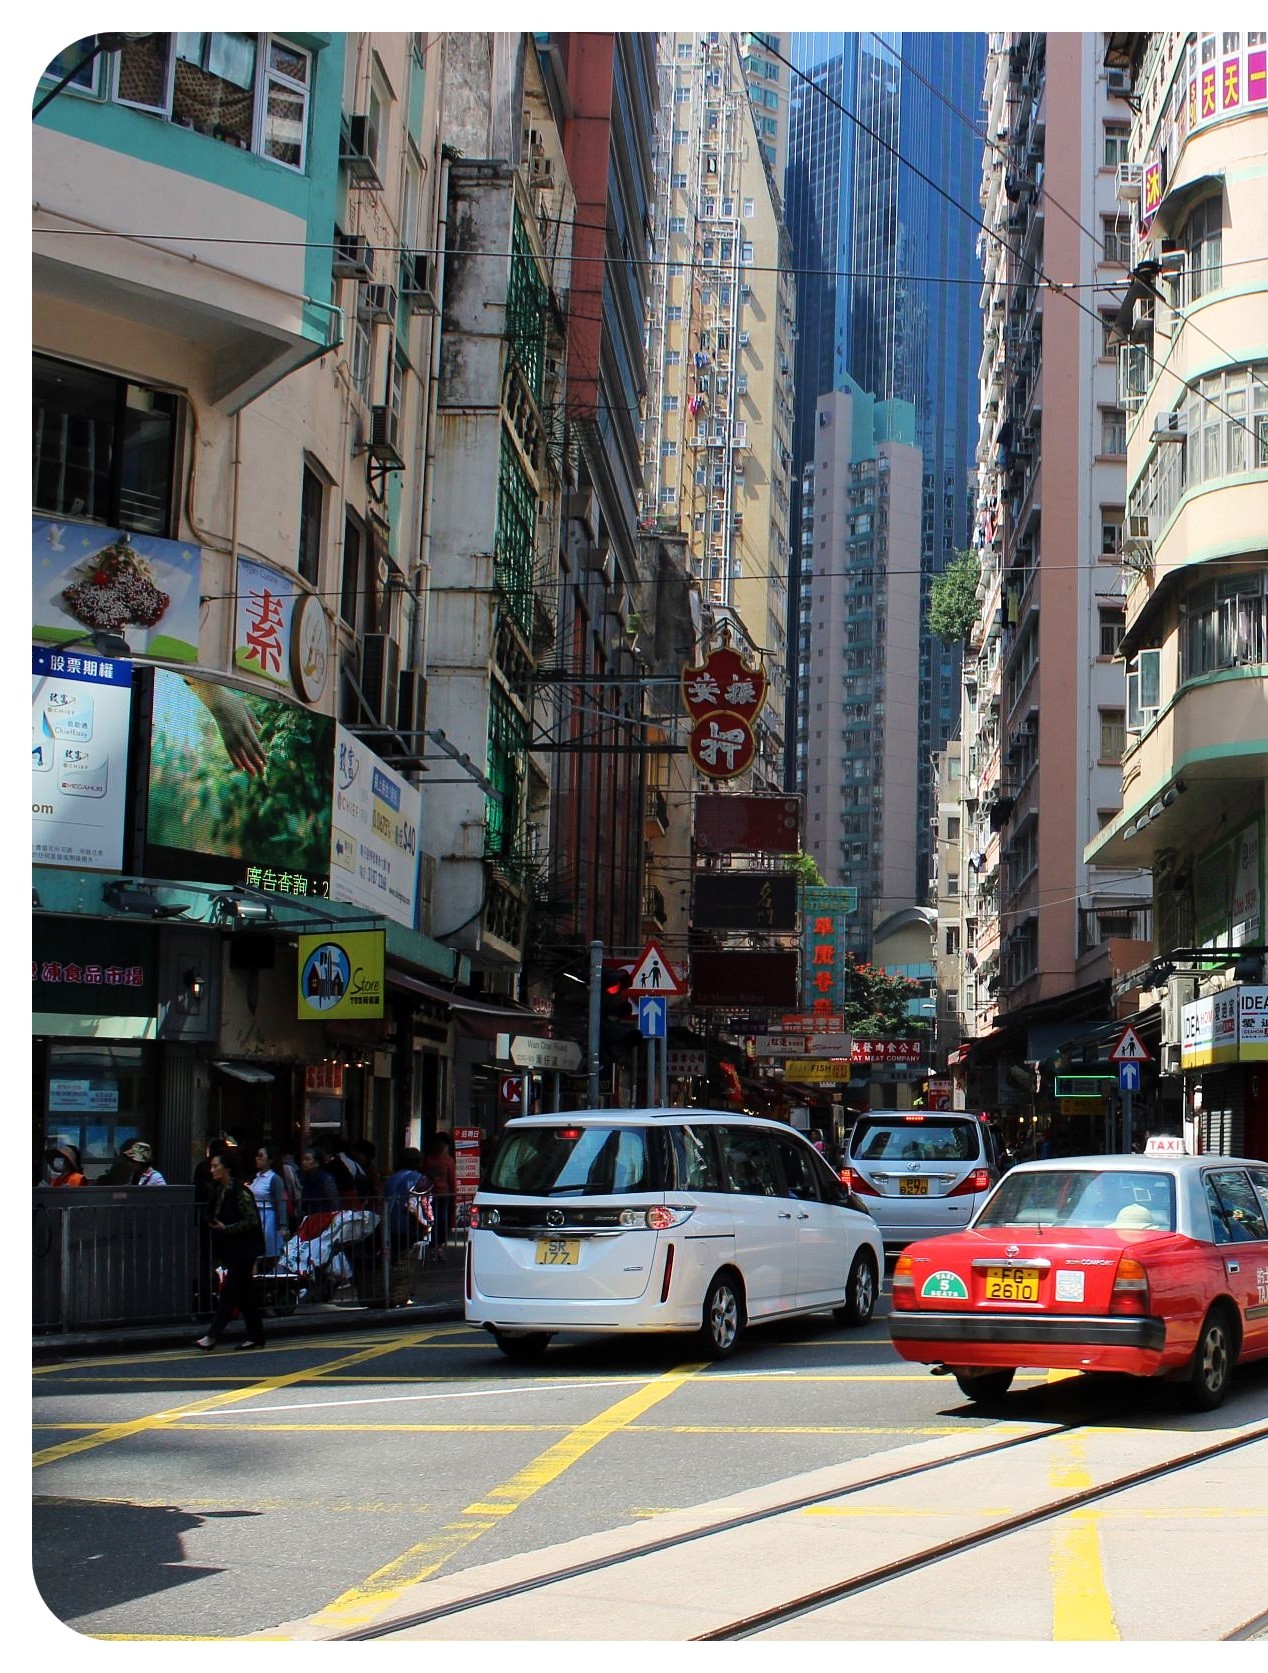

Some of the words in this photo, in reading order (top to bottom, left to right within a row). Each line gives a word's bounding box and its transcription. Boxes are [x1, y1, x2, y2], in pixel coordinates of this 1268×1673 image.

[244, 588, 284, 673] 素
[700, 722, 746, 769] 押
[1149, 1140, 1181, 1151] TAXI
[900, 1185, 927, 1195] 8270
[548, 1241, 565, 1251] SR
[1001, 1269, 1024, 1283] FG
[939, 1279, 950, 1290] 5
[991, 1284, 1032, 1299] 2610
